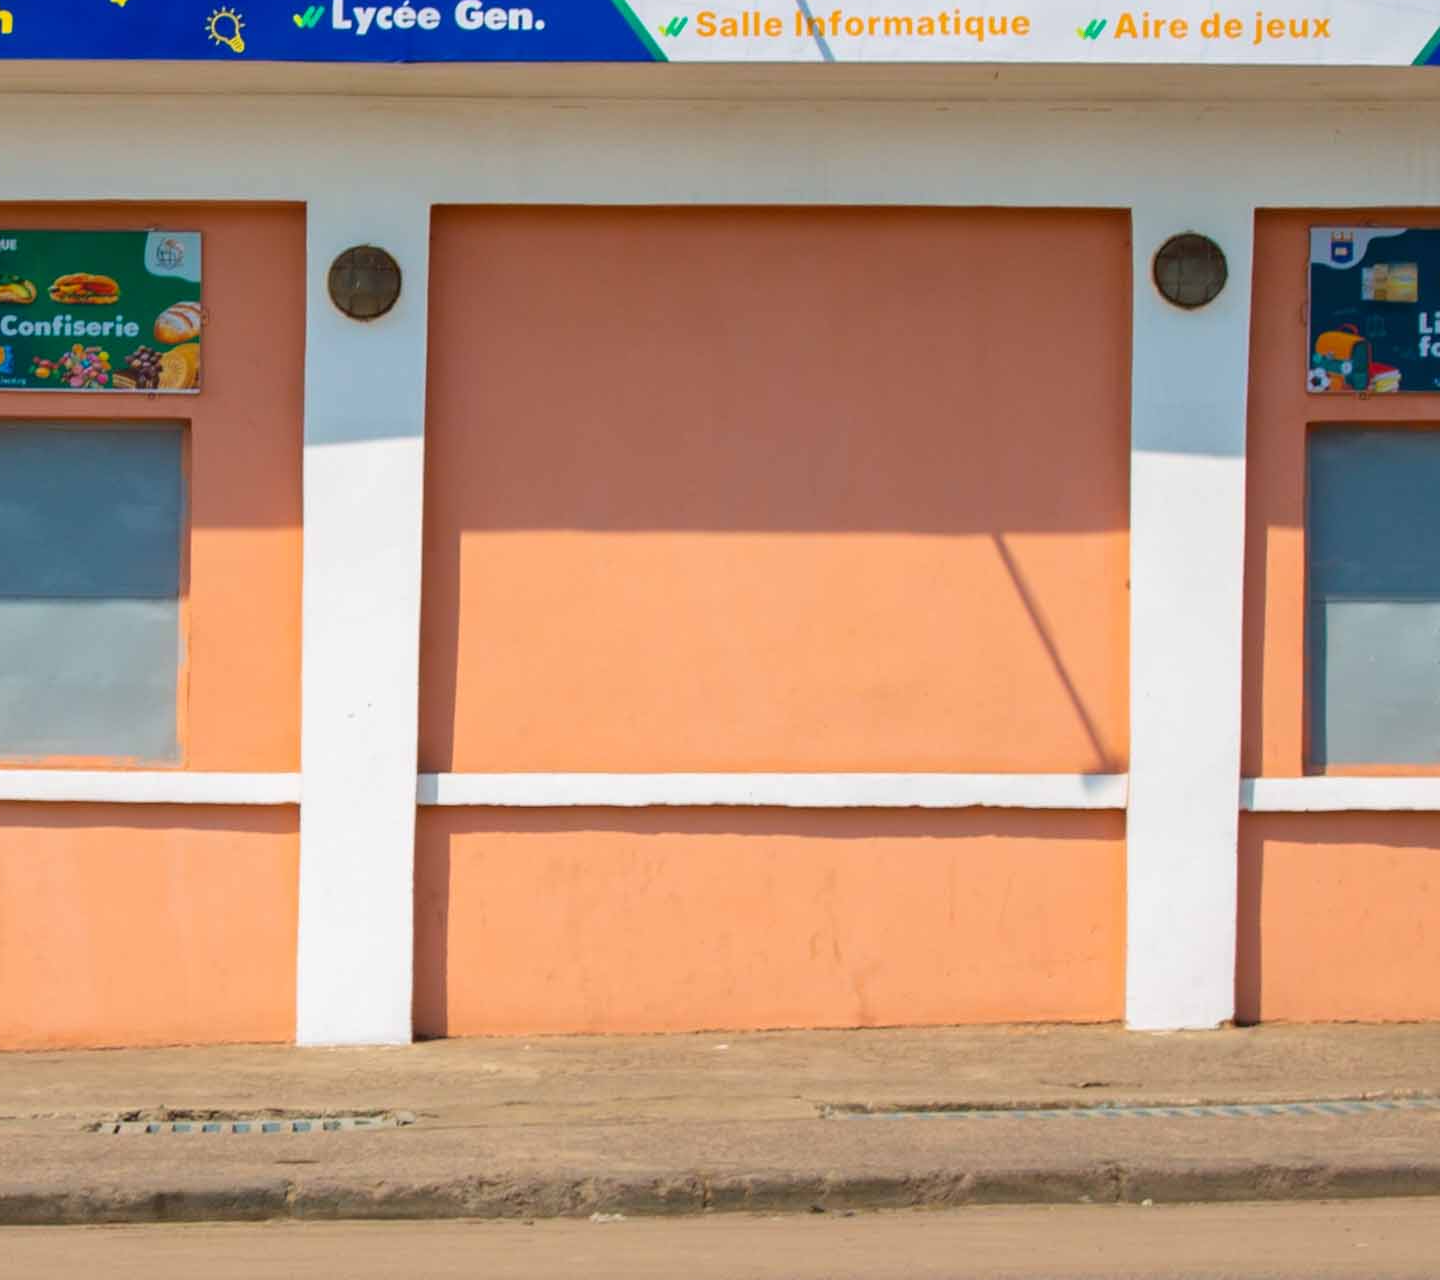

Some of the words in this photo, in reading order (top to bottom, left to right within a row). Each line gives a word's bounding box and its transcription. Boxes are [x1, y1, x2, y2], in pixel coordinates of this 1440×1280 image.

[455, 0, 545, 31] Gen.
[695, 10, 784, 39] Salle
[794, 10, 1031, 44] Informatique
[1114, 11, 1188, 39] Aire
[1199, 12, 1244, 39] de
[1252, 11, 1331, 44] jeux
[0, 314, 140, 338] Confiserie
